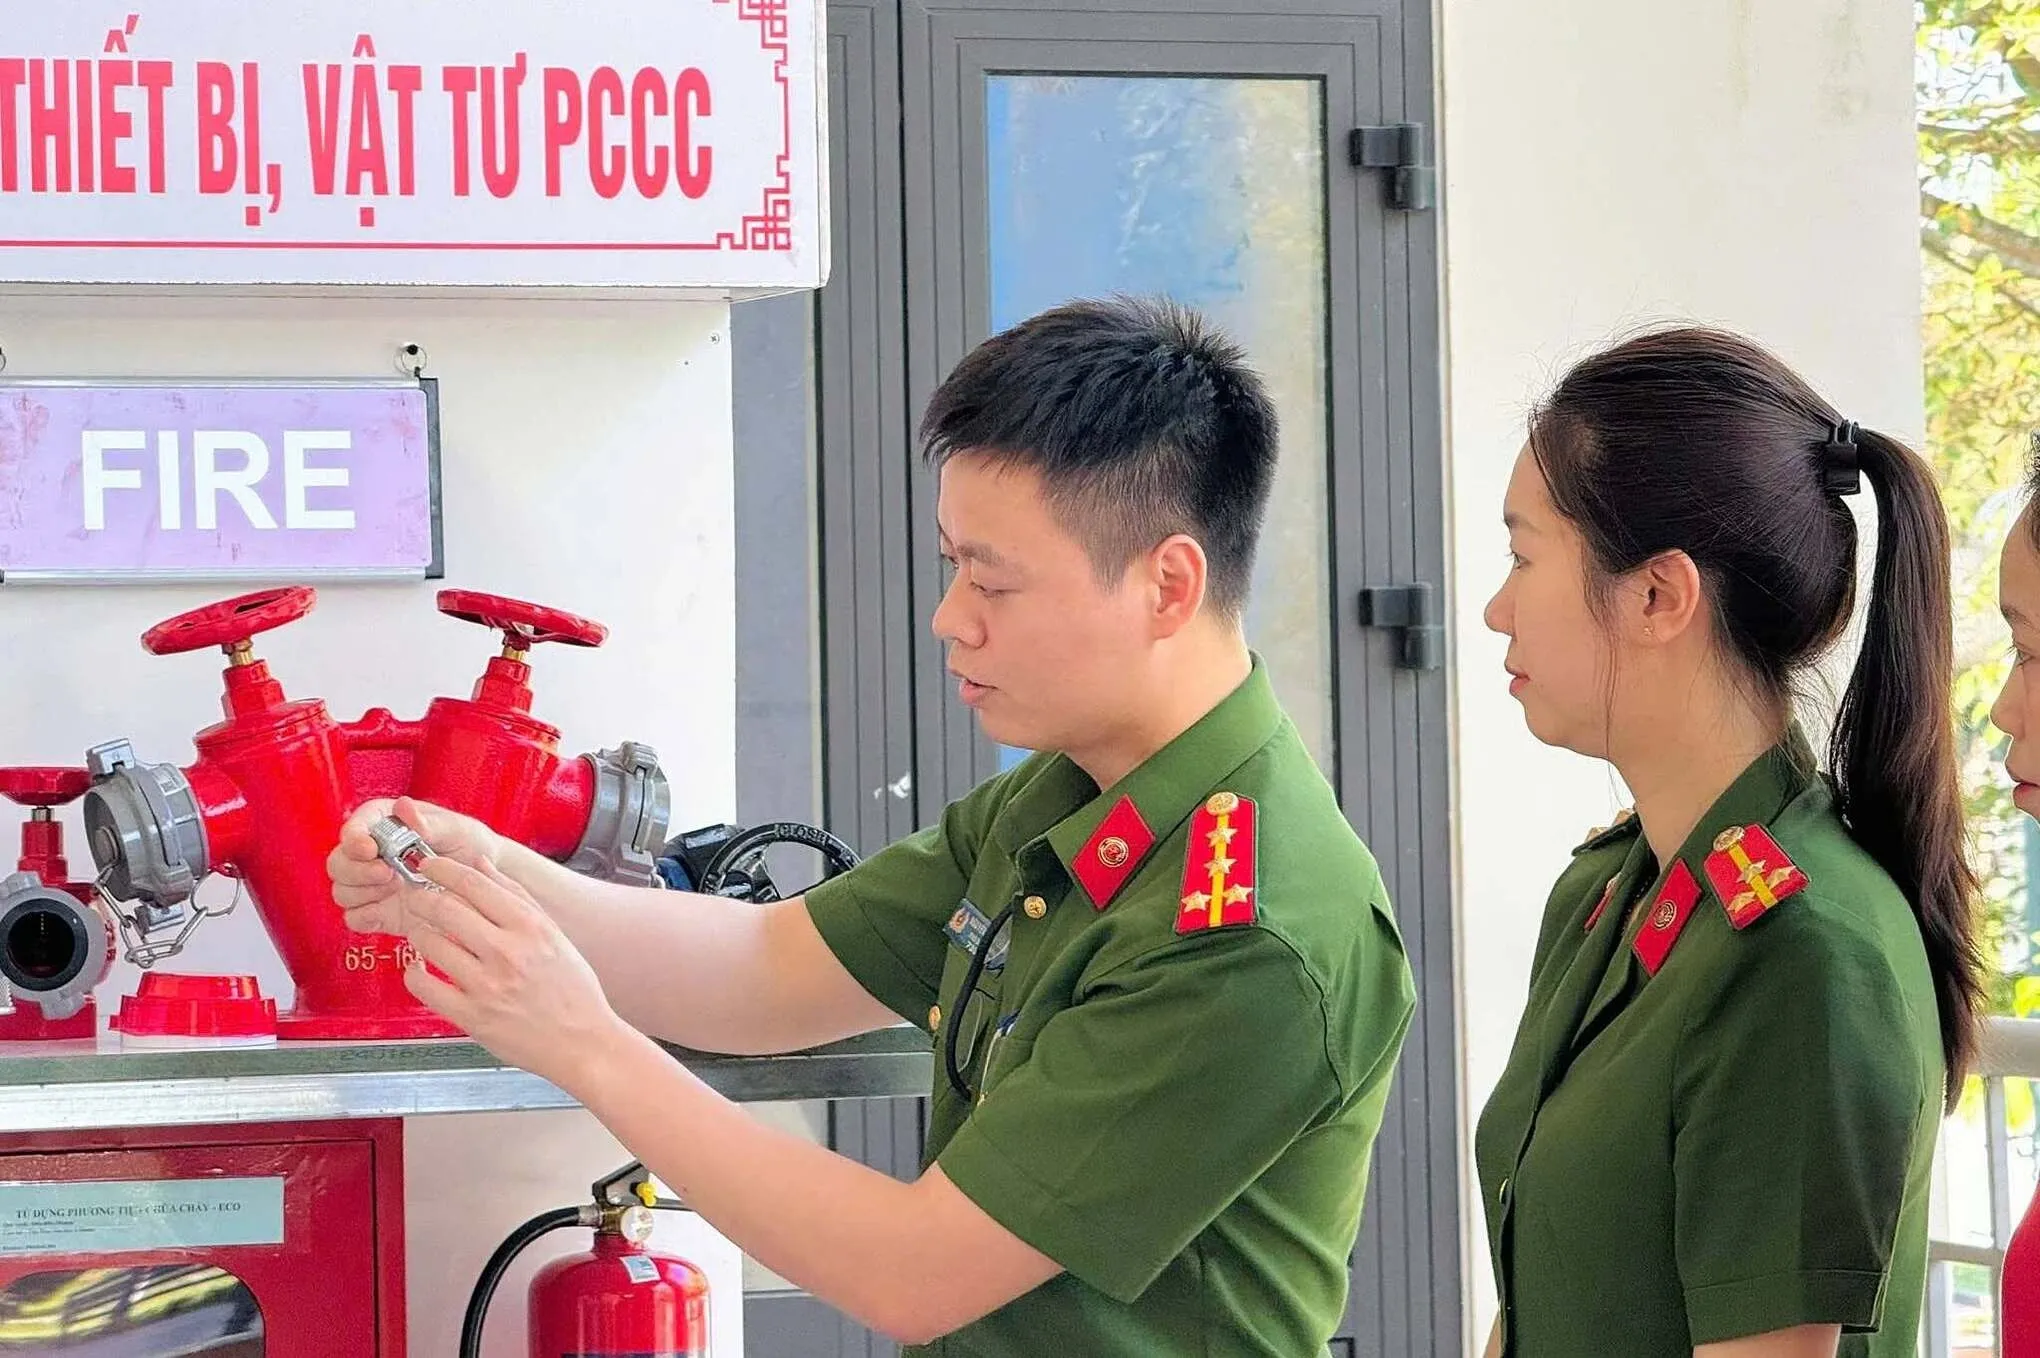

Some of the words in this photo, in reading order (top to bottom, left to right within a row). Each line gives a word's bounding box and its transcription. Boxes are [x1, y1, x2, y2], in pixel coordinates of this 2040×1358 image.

[0, 14, 173, 193] THIẾT
[197, 61, 281, 227] BỊ,
[302, 34, 422, 227] VẬT
[442, 52, 527, 199] TƯ
[544, 66, 712, 199] PCCC
[81, 430, 356, 530] FIRE
